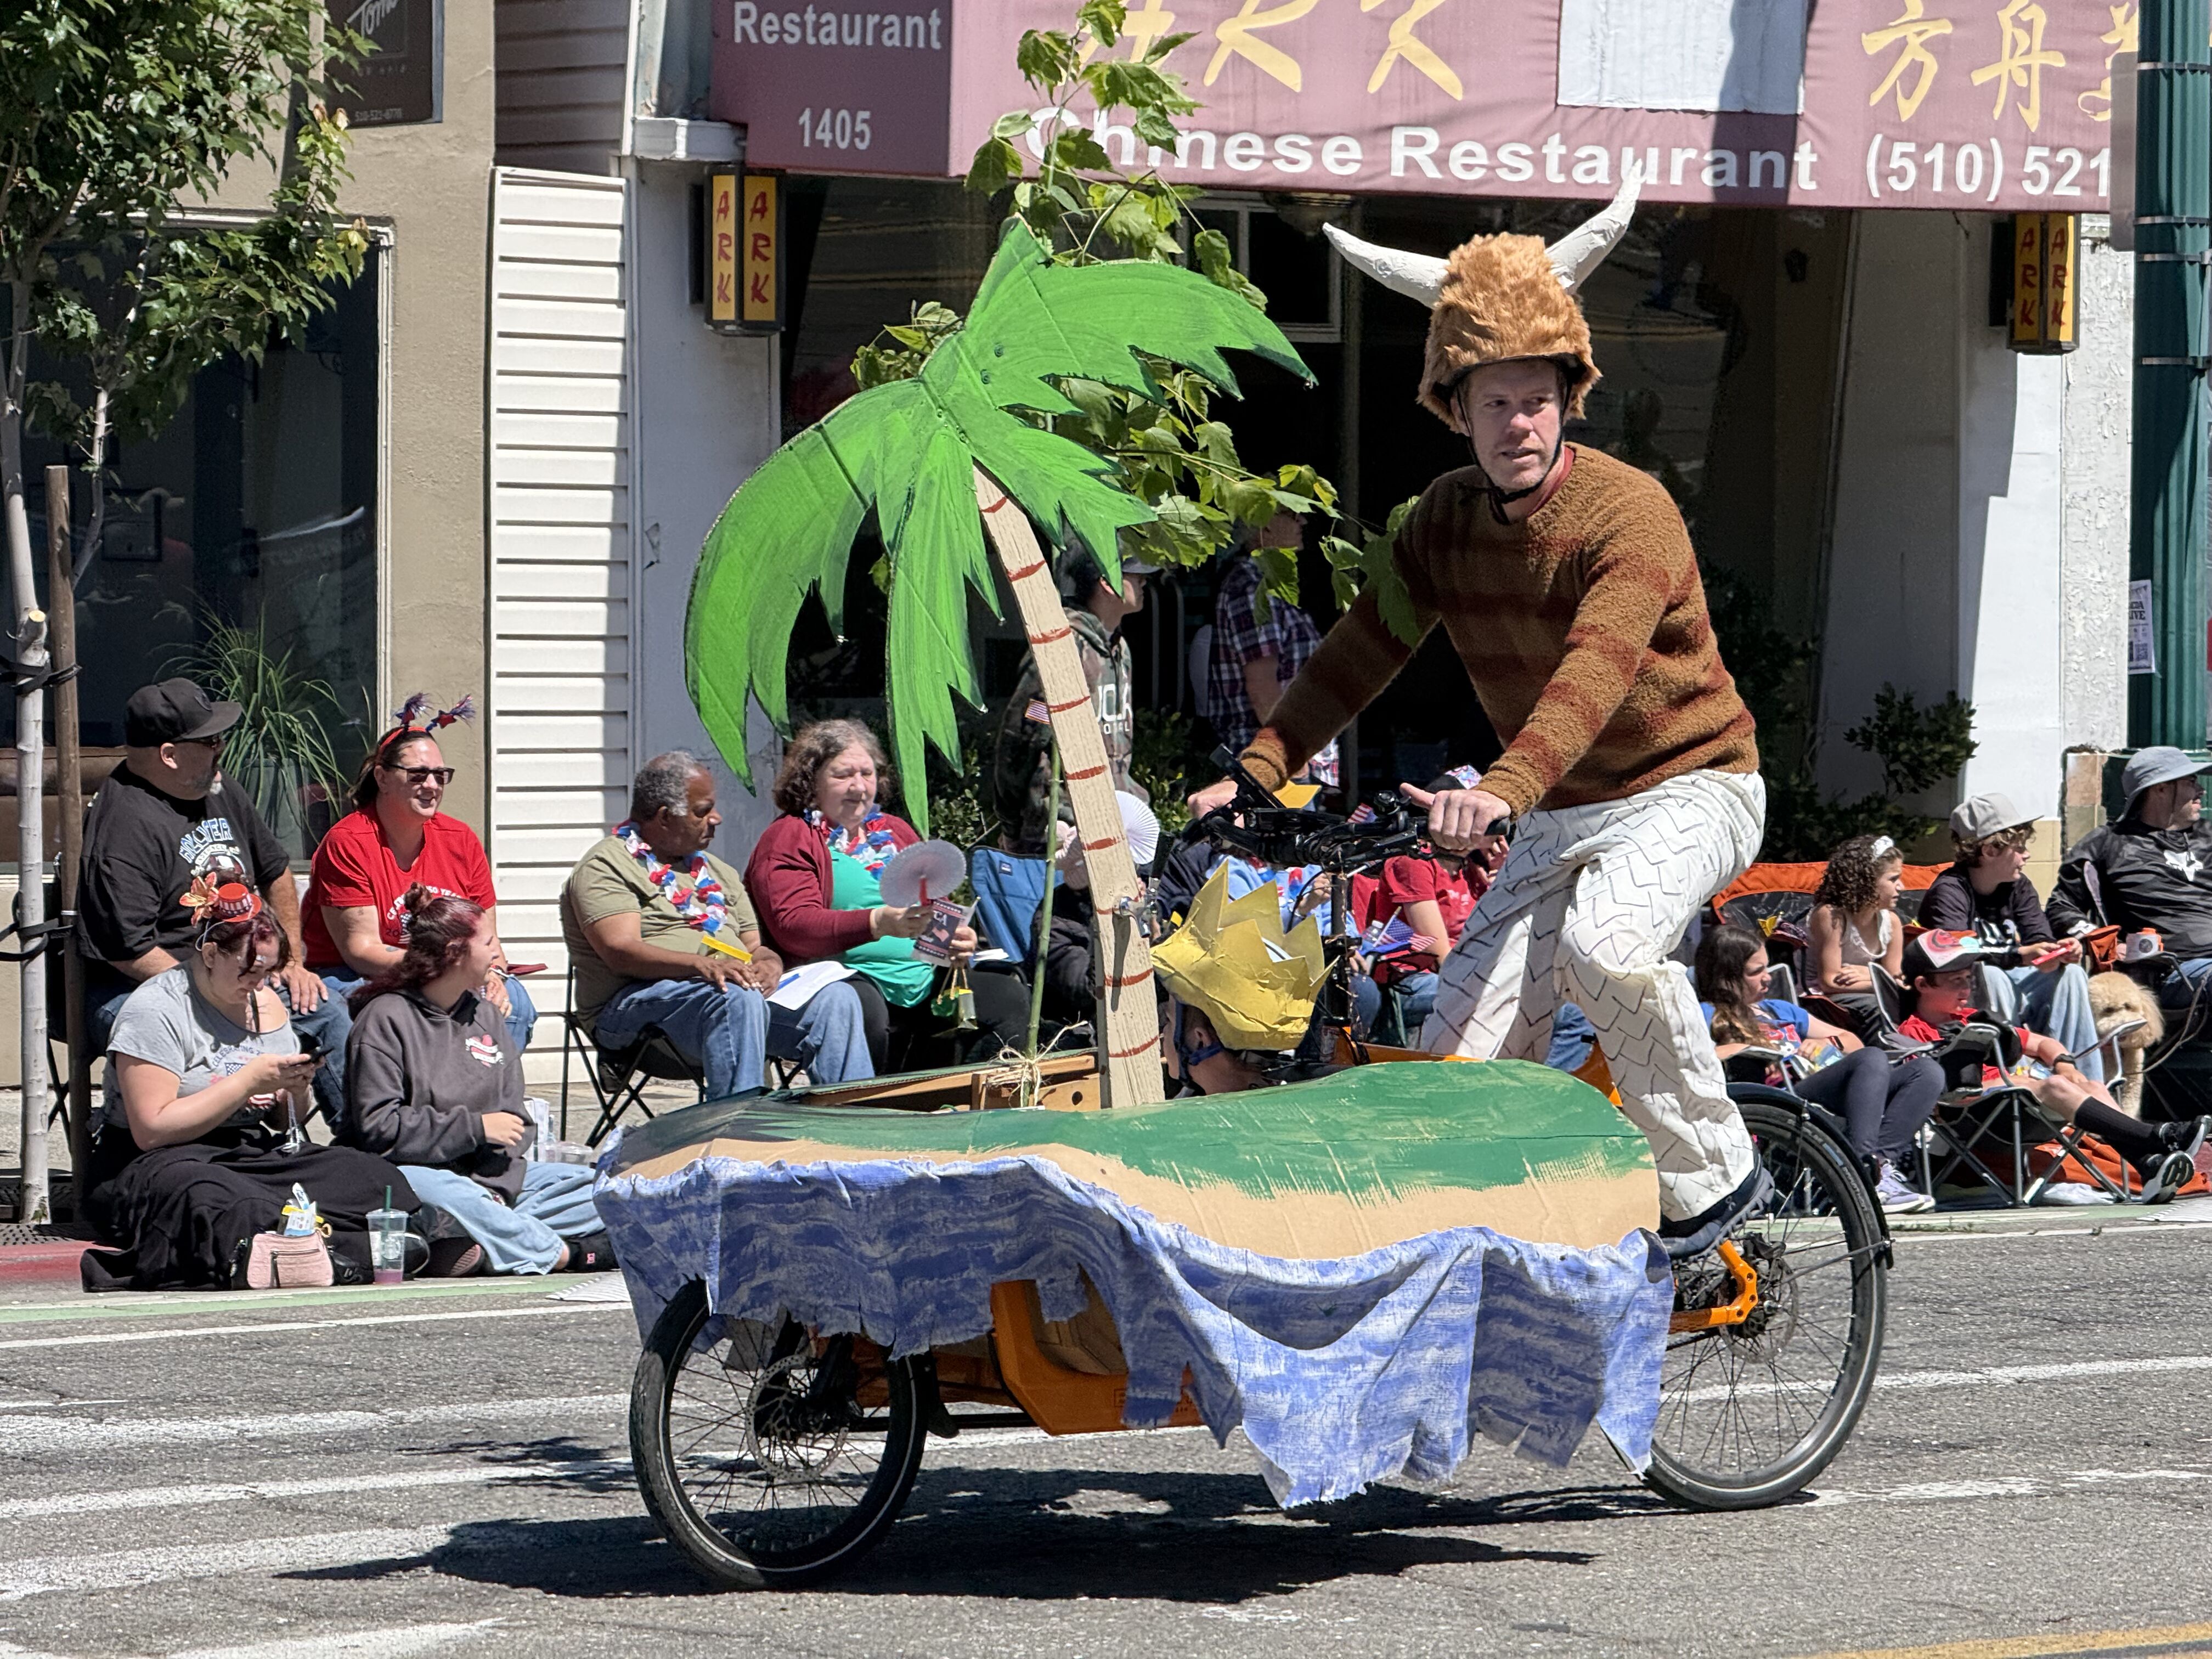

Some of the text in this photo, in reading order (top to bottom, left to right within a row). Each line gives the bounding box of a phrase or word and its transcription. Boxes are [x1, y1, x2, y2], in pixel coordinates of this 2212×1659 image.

[734, 1, 941, 50] Restaurant
[798, 108, 871, 150] 1405
[1391, 126, 1818, 190] Restaurant
[1866, 133, 2003, 202] (510)
[716, 190, 732, 303] ARK
[748, 190, 771, 303] ARK
[2019, 227, 2038, 324] ARK
[2051, 227, 2068, 323] ARK
